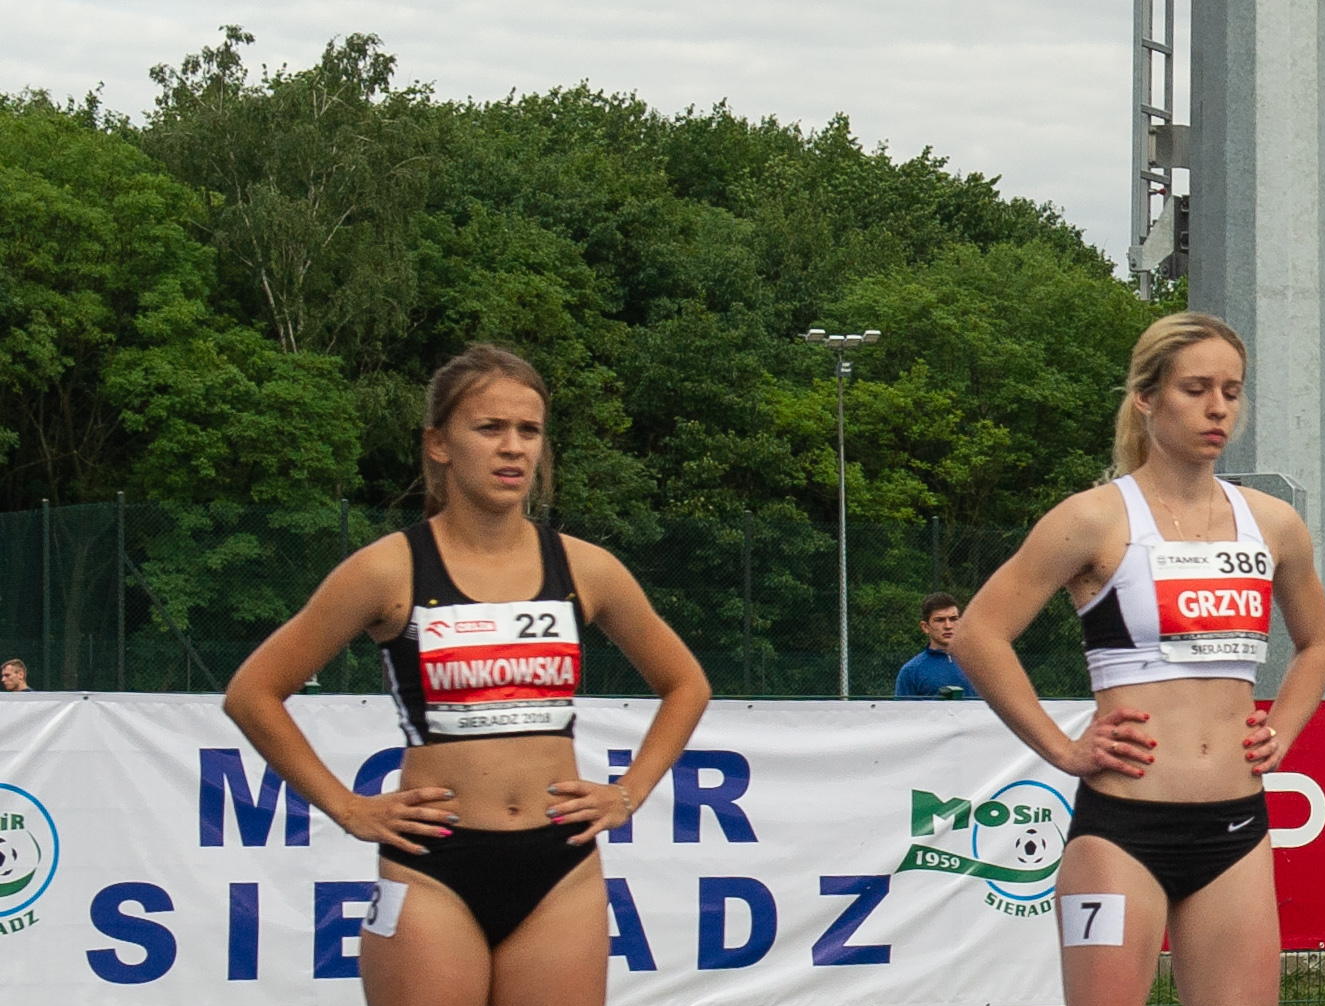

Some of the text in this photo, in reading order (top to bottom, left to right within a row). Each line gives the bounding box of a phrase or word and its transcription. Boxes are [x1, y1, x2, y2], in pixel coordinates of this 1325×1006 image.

[1216, 552, 1267, 575] 386
[1177, 590, 1263, 618] GRZYB
[516, 613, 560, 638] 22
[1191, 643, 1239, 656] SIERADZ
[425, 656, 575, 691] WINKOWSKA
[458, 712, 518, 728] SIERADZ
[199, 748, 758, 846] MiR
[914, 850, 961, 870] 1959
[86, 874, 891, 984] SIEADZ
[1080, 902, 1102, 939] 7
